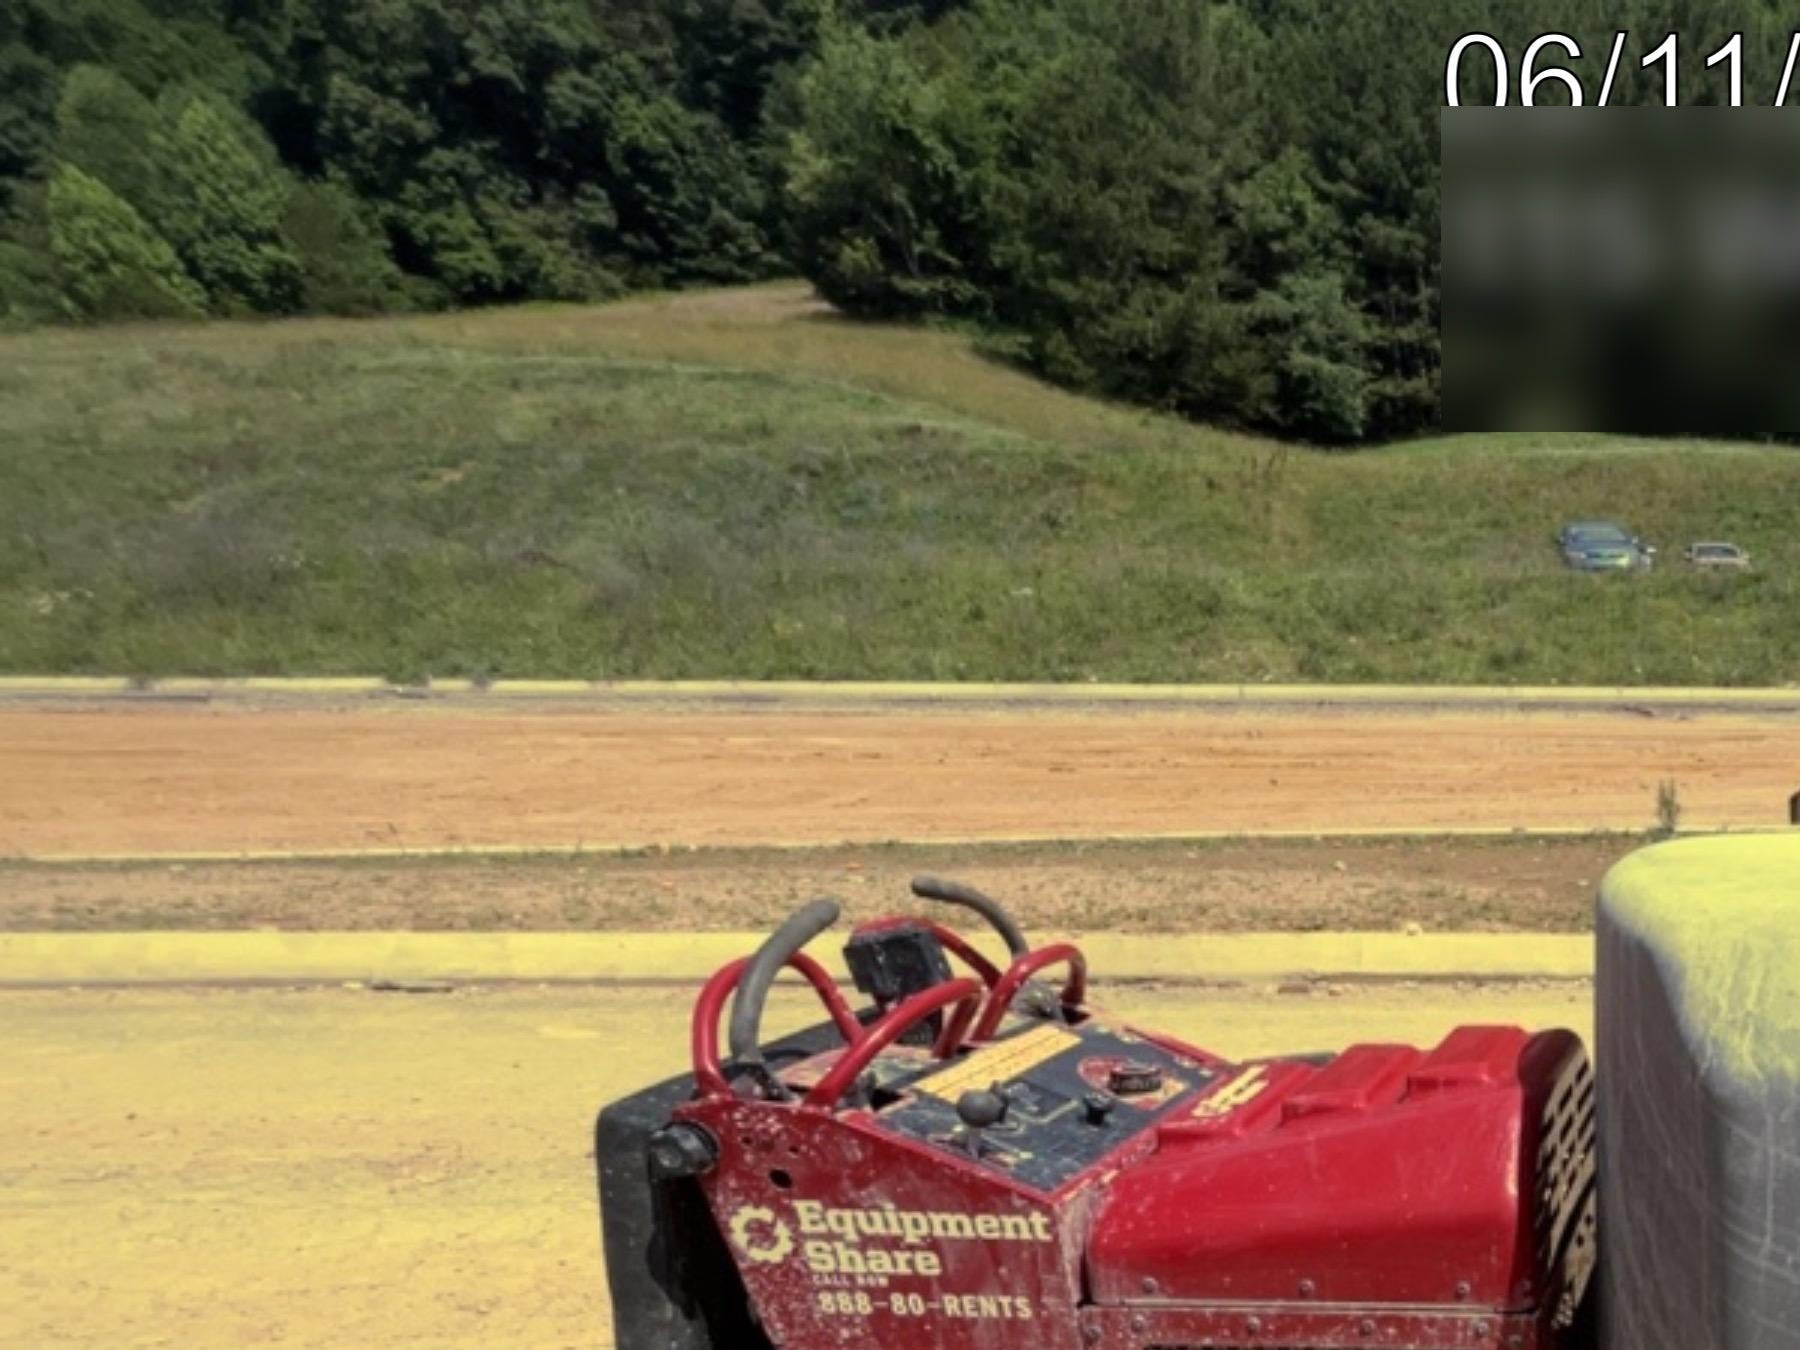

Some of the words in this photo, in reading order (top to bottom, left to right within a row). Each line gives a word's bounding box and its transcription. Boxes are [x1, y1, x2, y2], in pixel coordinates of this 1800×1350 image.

[792, 1199, 1053, 1246] Equipment
[804, 1240, 943, 1276] Share
[816, 1291, 1033, 1321] 888-80-RENTS
